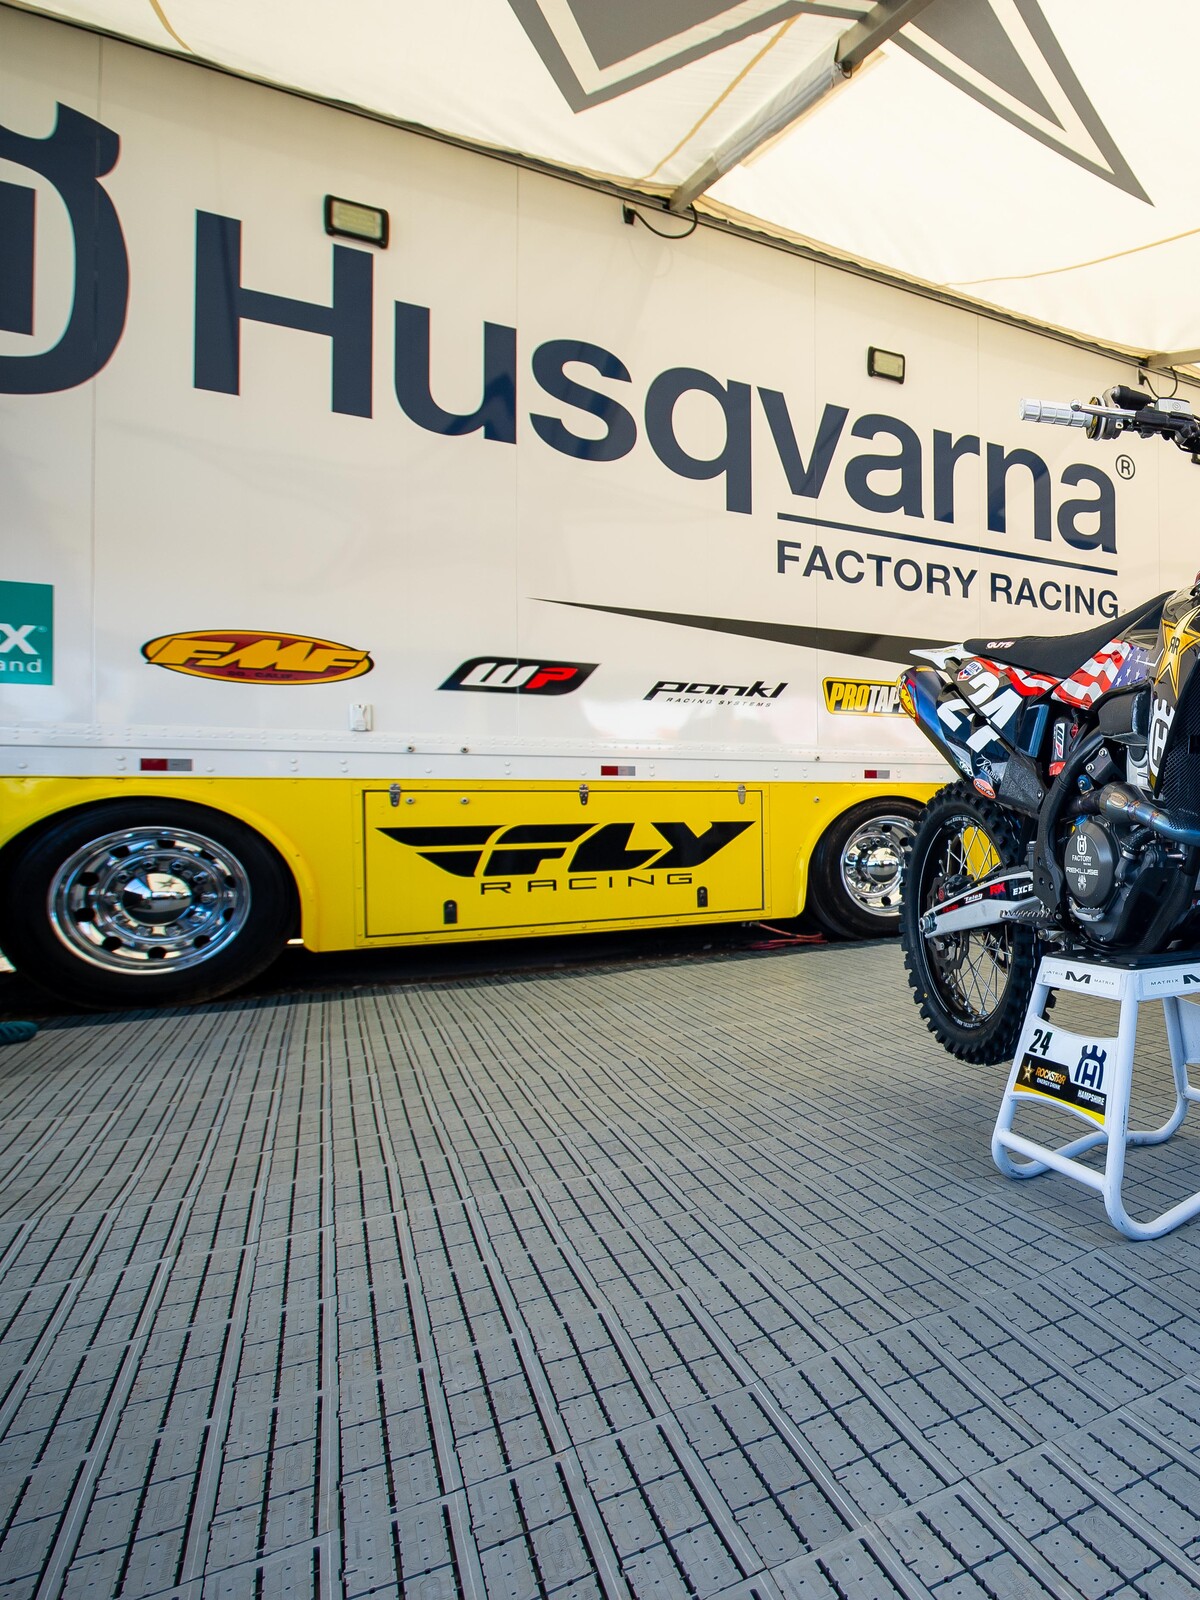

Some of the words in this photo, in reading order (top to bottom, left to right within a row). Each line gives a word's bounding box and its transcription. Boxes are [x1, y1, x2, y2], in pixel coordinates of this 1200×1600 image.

[777, 539, 978, 600] FACTORY
[988, 572, 1120, 620] RACING
[146, 637, 370, 674] FMF
[665, 697, 712, 706] RACING
[719, 699, 773, 708] SYSTEMS
[829, 682, 907, 714] PROTAP
[470, 821, 757, 877] FLY
[1070, 854, 1093, 863] FACTORY
[480, 873, 694, 896] RACING
[989, 881, 1006, 896] RK
[1012, 883, 1034, 896] EXCE
[1150, 978, 1180, 986] MATRIX
[1028, 1028, 1054, 1056] 24
[1035, 1066, 1067, 1085] ROCKSTAR
